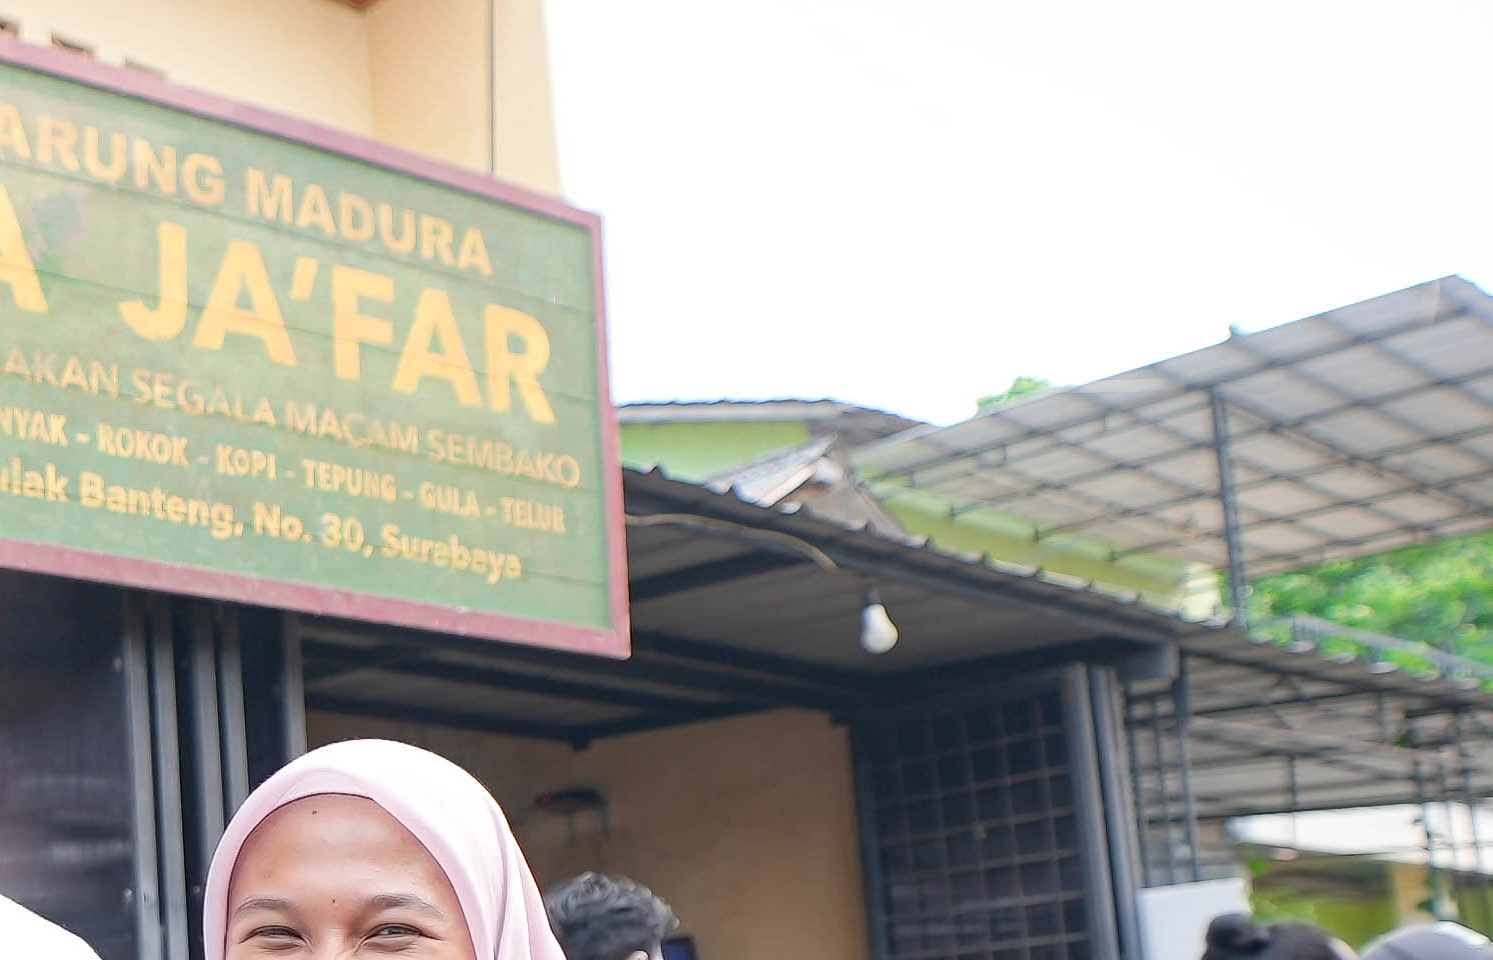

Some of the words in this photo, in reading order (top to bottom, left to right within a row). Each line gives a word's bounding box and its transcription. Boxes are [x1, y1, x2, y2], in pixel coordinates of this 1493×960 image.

[245, 167, 493, 277] MADURA
[119, 222, 556, 424] JA'FAR
[97, 423, 190, 468] ROKOK
[216, 444, 277, 481] KOPI
[301, 458, 397, 502] TEPUNG
[419, 481, 481, 518] GULA
[501, 496, 567, 534] TELUR
[132, 367, 277, 428] SEGALA
[426, 429, 581, 488] SEMBAKO
[79, 471, 245, 540] Banteng,
[254, 501, 314, 543] No.
[320, 511, 375, 559] 30,
[380, 522, 522, 585] Surabaya
